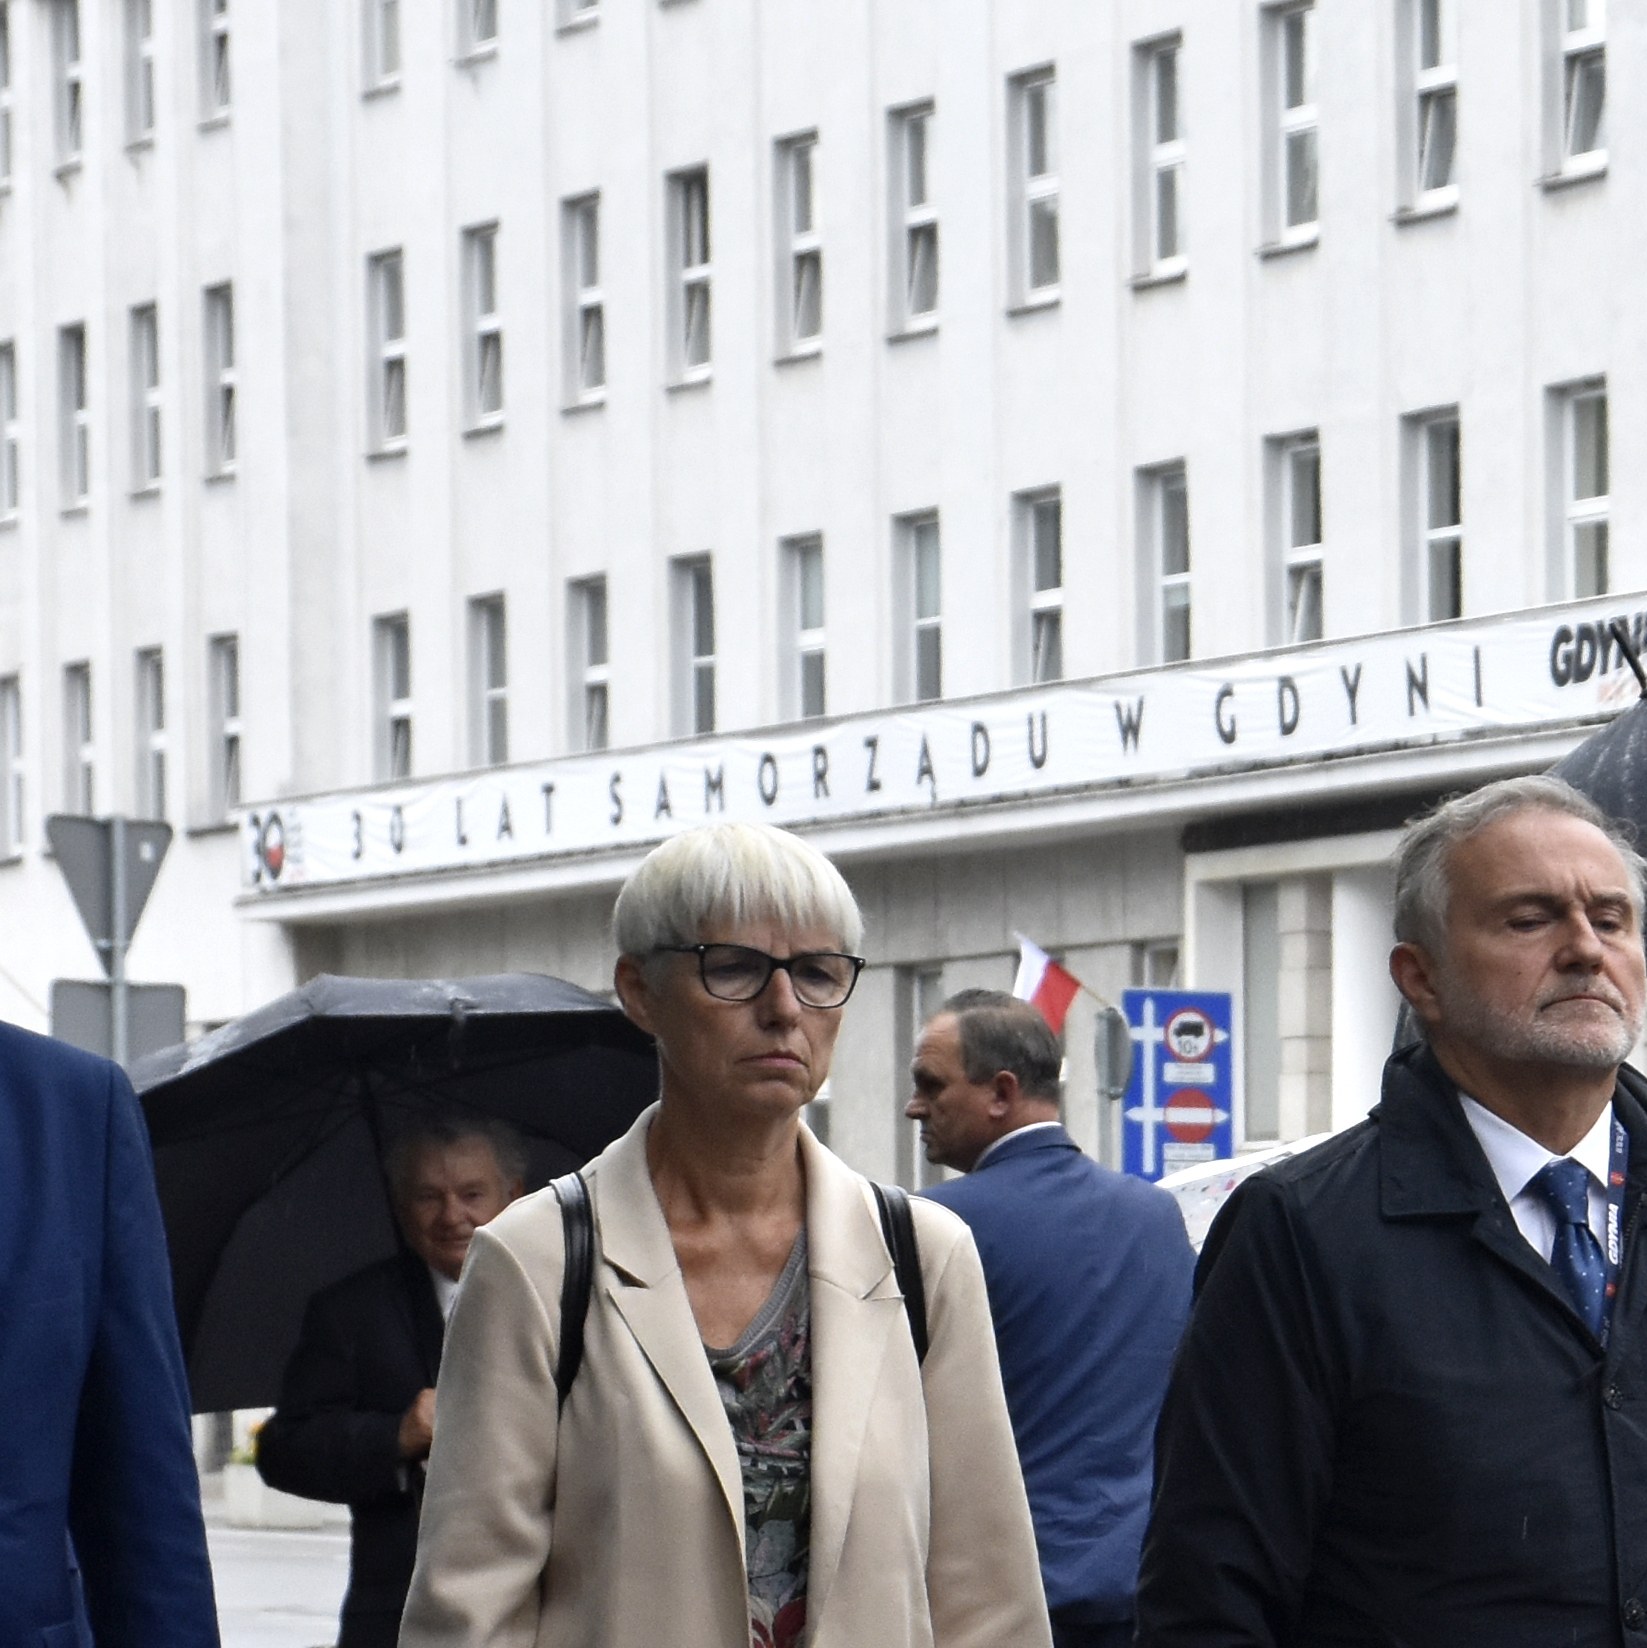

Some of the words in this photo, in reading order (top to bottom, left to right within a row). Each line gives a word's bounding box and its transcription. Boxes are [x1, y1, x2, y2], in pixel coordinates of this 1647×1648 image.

[351, 806, 406, 861] 30
[455, 783, 556, 846] LAT
[609, 714, 1047, 826] SAMORZĄDU
[1114, 694, 1145, 754] W
[1213, 645, 1484, 746] GDYNI
[1608, 1203, 1619, 1265] GDYNIA
